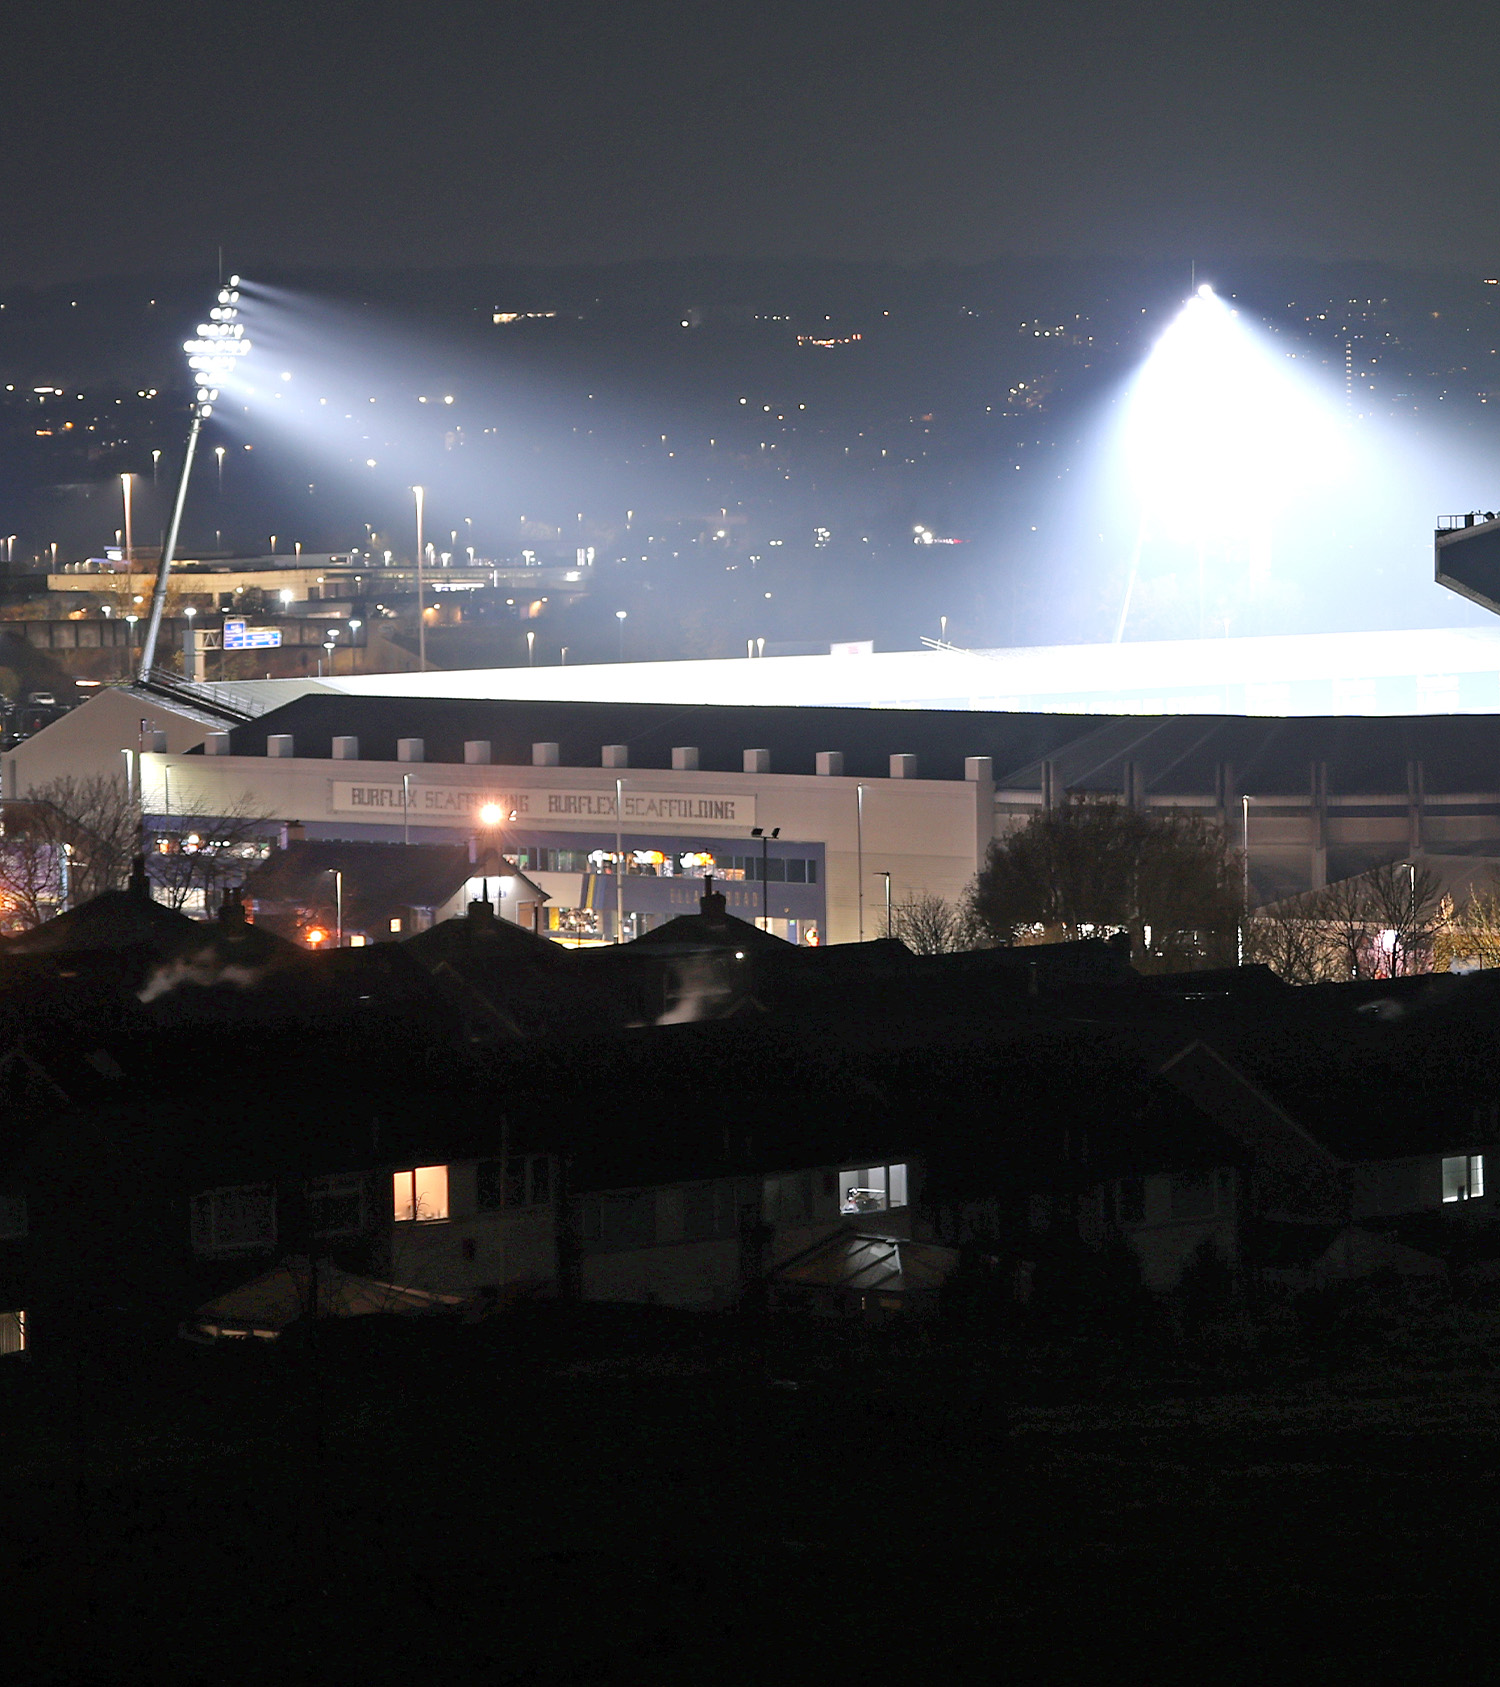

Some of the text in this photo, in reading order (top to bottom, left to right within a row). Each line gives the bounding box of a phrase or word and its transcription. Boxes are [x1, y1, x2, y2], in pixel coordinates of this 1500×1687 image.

[351, 787, 417, 808] BURFLEX
[548, 795, 616, 815] BURFLEX
[625, 797, 735, 820] SCAFFOLDING
